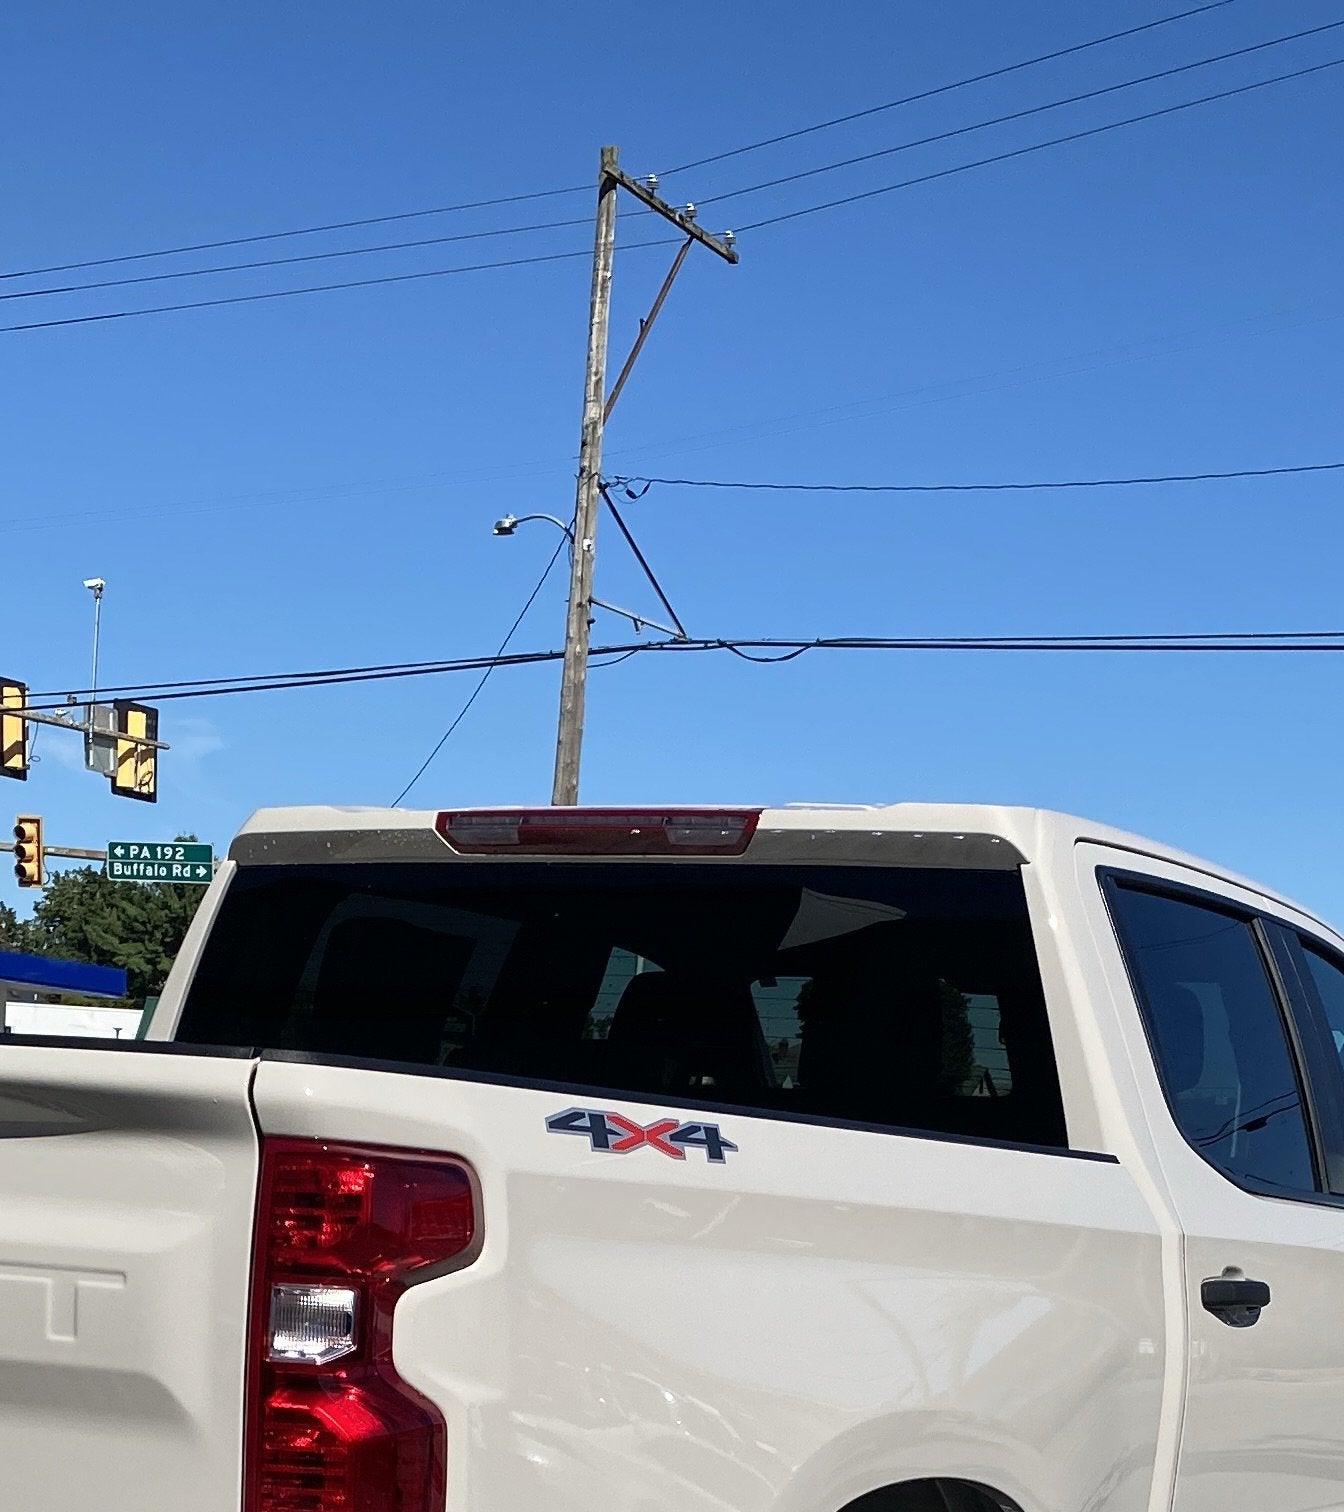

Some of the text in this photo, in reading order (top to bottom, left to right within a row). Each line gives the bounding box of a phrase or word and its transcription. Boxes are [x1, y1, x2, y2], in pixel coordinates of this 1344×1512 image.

[129, 845, 185, 860] PA 192
[113, 862, 191, 878] Buffalo Rd
